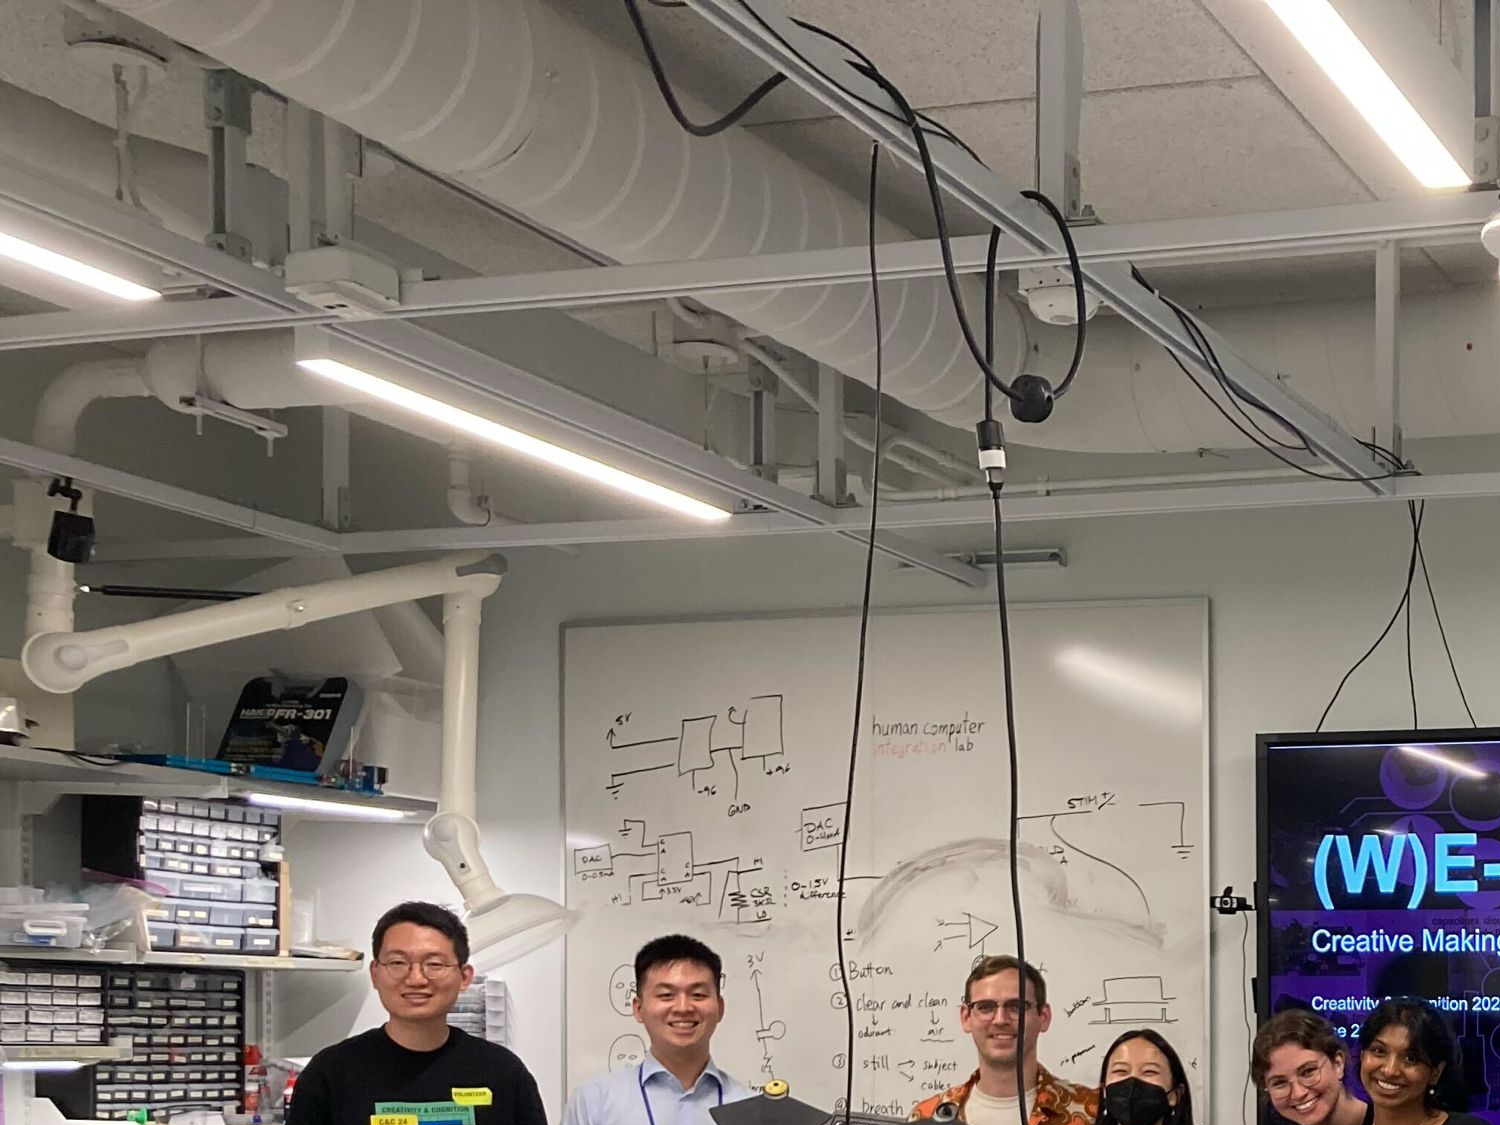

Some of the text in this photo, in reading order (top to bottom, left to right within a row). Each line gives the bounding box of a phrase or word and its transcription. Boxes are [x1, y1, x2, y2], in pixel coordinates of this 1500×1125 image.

[274, 708, 332, 720] FR-301
[871, 711, 985, 743] human computer
[873, 738, 974, 759] integration lab
[727, 803, 751, 816] GND
[803, 818, 834, 834] DAC
[581, 855, 602, 864] DAC
[1311, 927, 1414, 953] Creative
[849, 961, 894, 981] Button
[856, 993, 886, 1012] clear
[891, 994, 912, 1009] and
[918, 991, 948, 1008] clean
[928, 1027, 944, 1036] air
[863, 1055, 889, 1071] still
[923, 1058, 958, 1075] subject
[382, 1105, 470, 1114] CREATIVITY & COGNITION
[862, 1098, 904, 1116] breath
[379, 1118, 408, 1125] C&C 24
